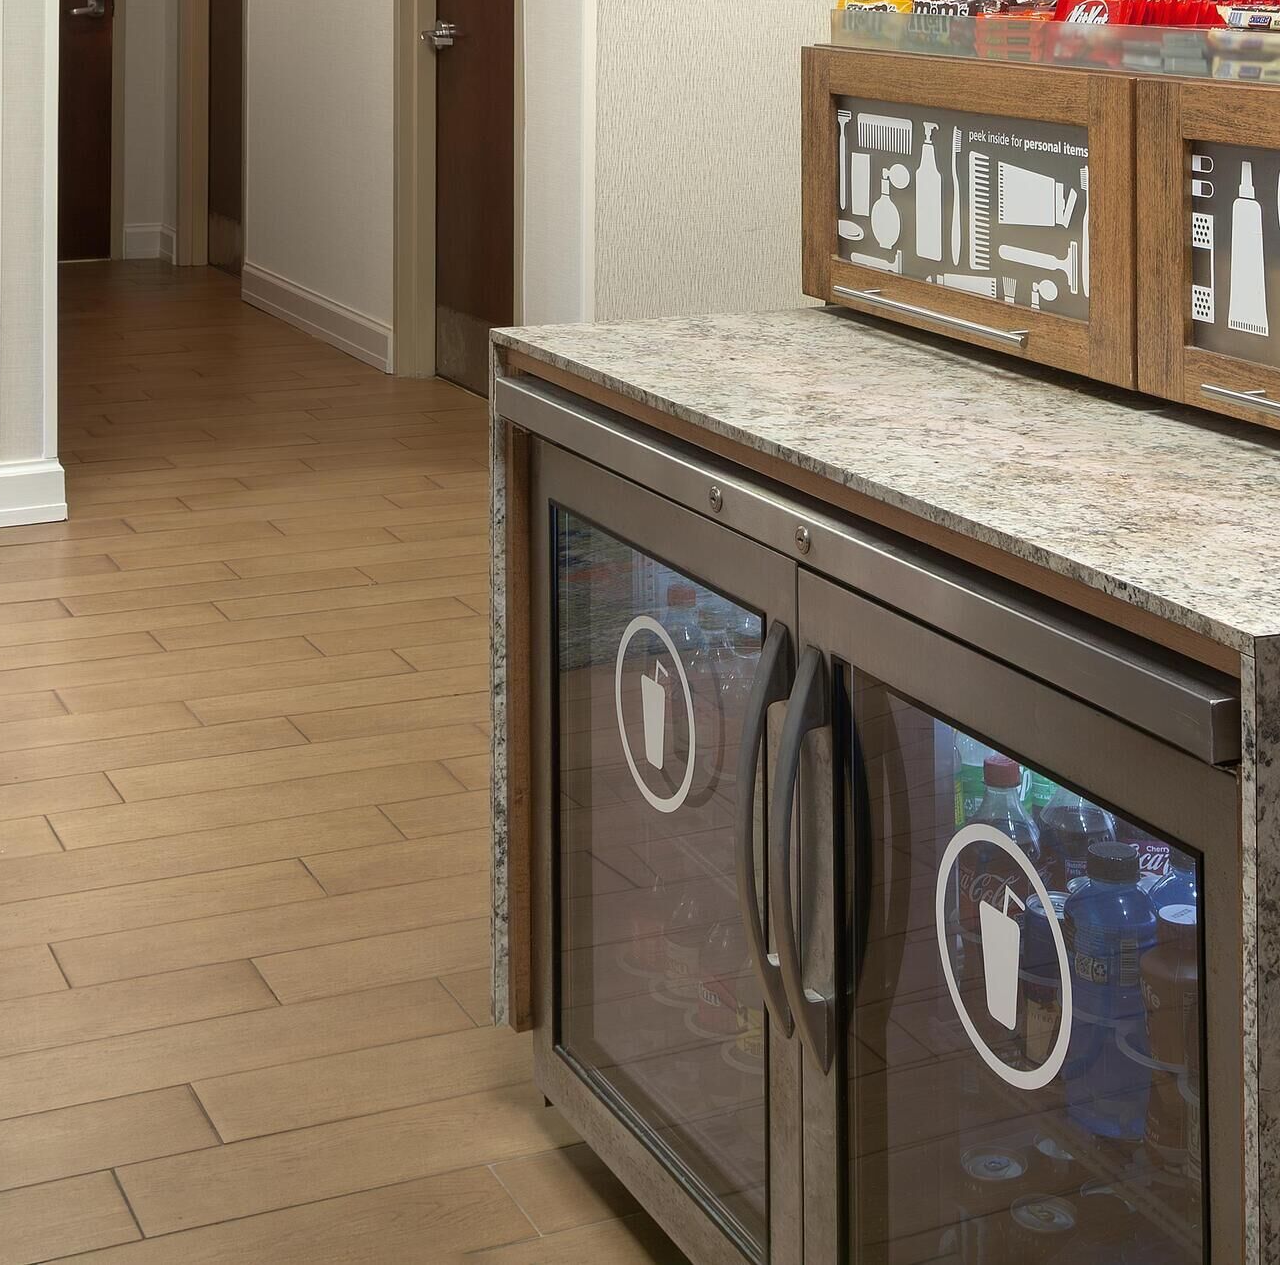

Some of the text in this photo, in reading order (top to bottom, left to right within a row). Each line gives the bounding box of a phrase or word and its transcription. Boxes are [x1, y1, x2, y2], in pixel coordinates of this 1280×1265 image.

[969, 130, 1089, 157] peek inside for personal items
